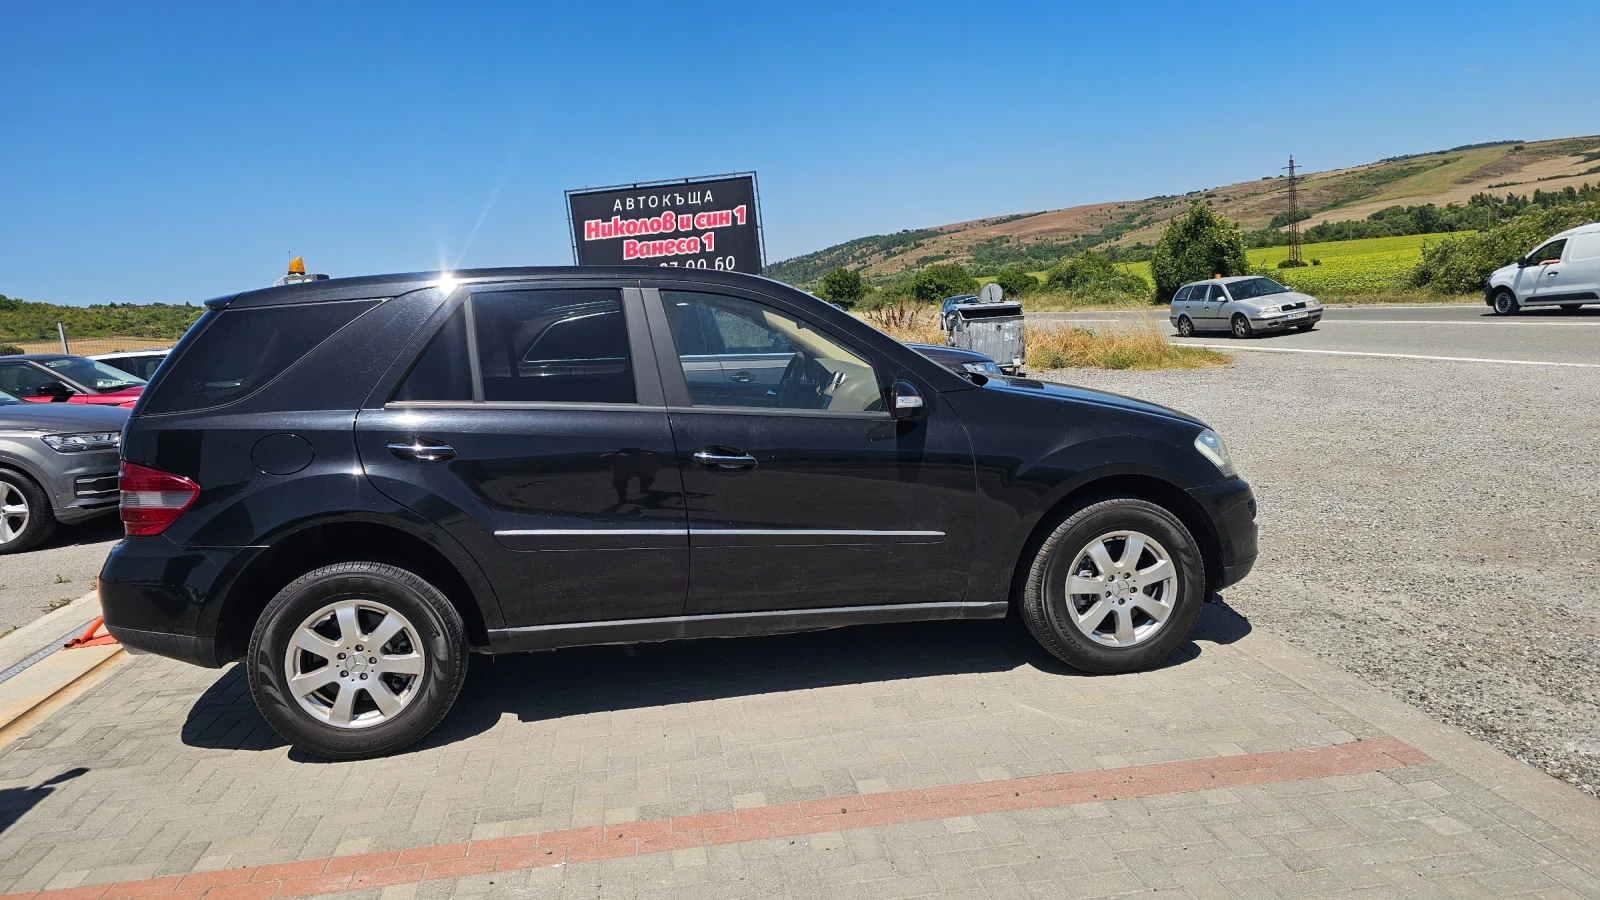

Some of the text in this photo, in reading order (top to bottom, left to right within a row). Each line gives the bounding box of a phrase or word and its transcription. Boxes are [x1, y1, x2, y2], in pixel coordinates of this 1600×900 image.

[613, 190, 713, 211] АВТОКЪЩА
[585, 205, 747, 241] Николов и син 1
[623, 232, 715, 260] Ванеса 1
[715, 255, 735, 270] 60
